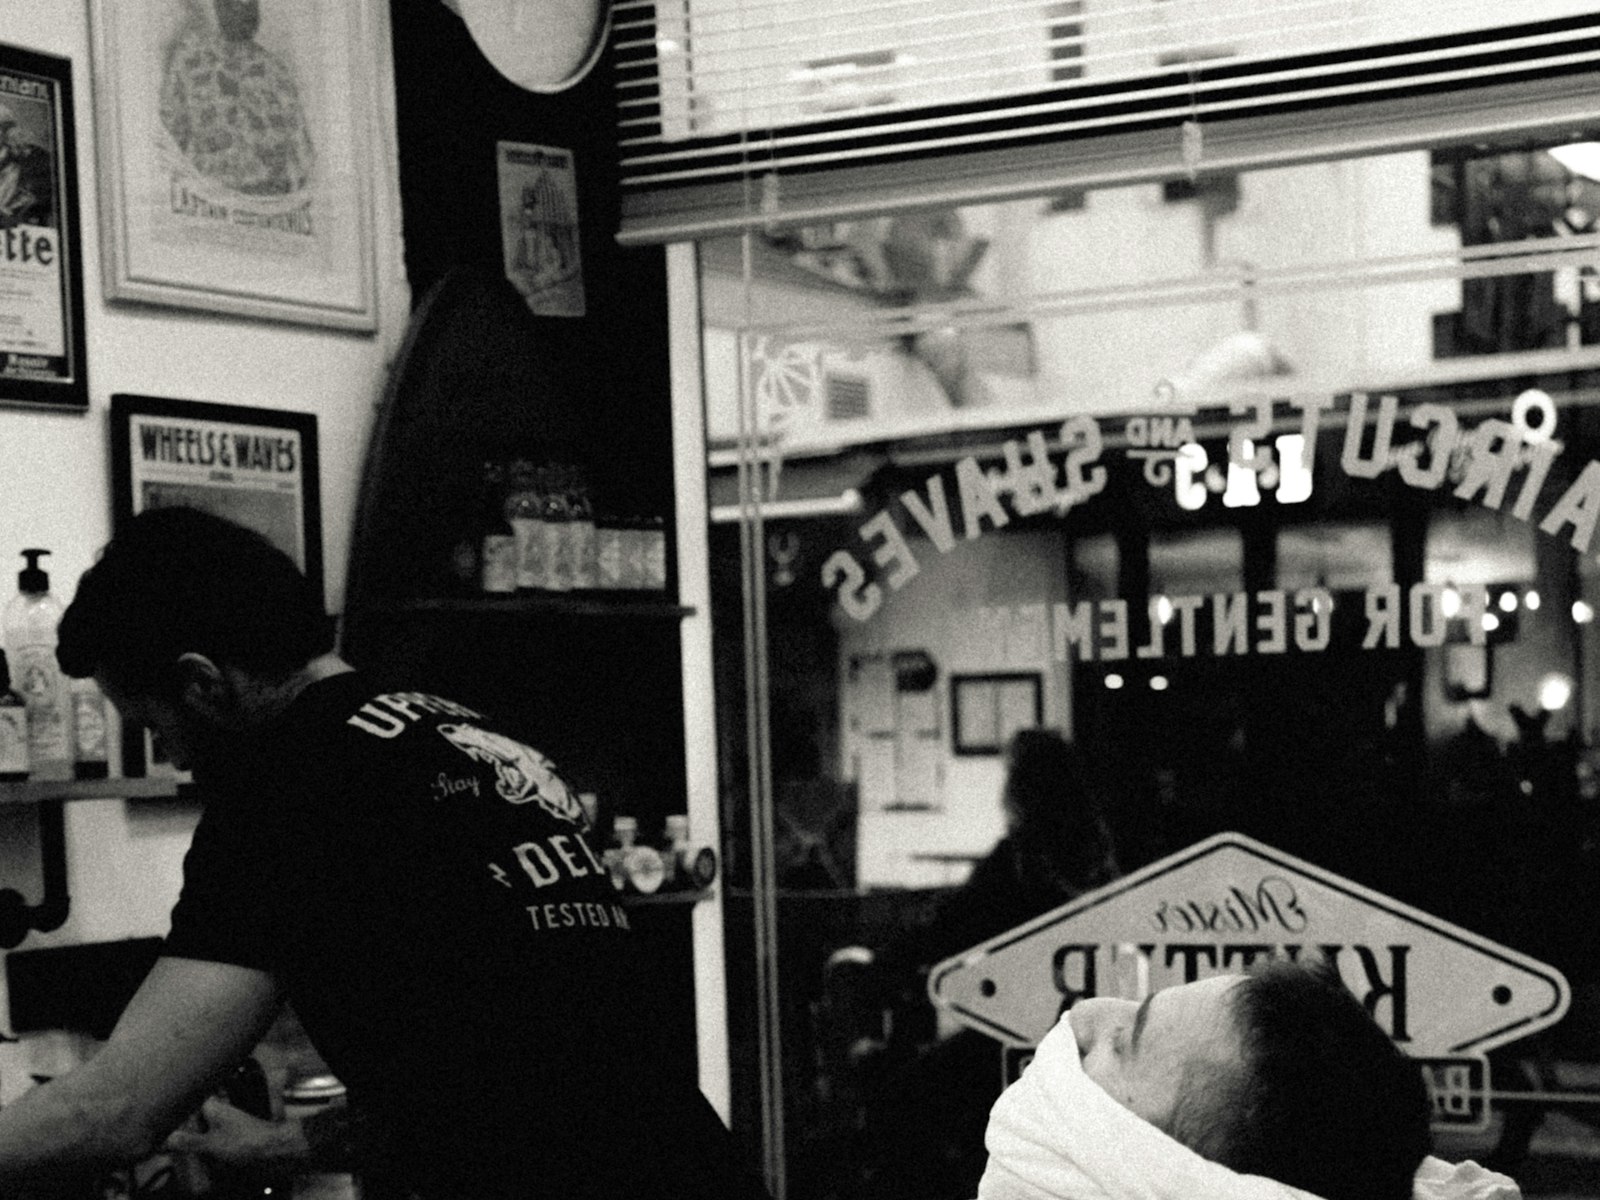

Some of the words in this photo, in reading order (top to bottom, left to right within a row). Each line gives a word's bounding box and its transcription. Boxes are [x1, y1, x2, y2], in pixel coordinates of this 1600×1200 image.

[139, 423, 216, 465] WHEELS
[233, 433, 297, 473] WAVES
[526, 903, 610, 931] TESTED
